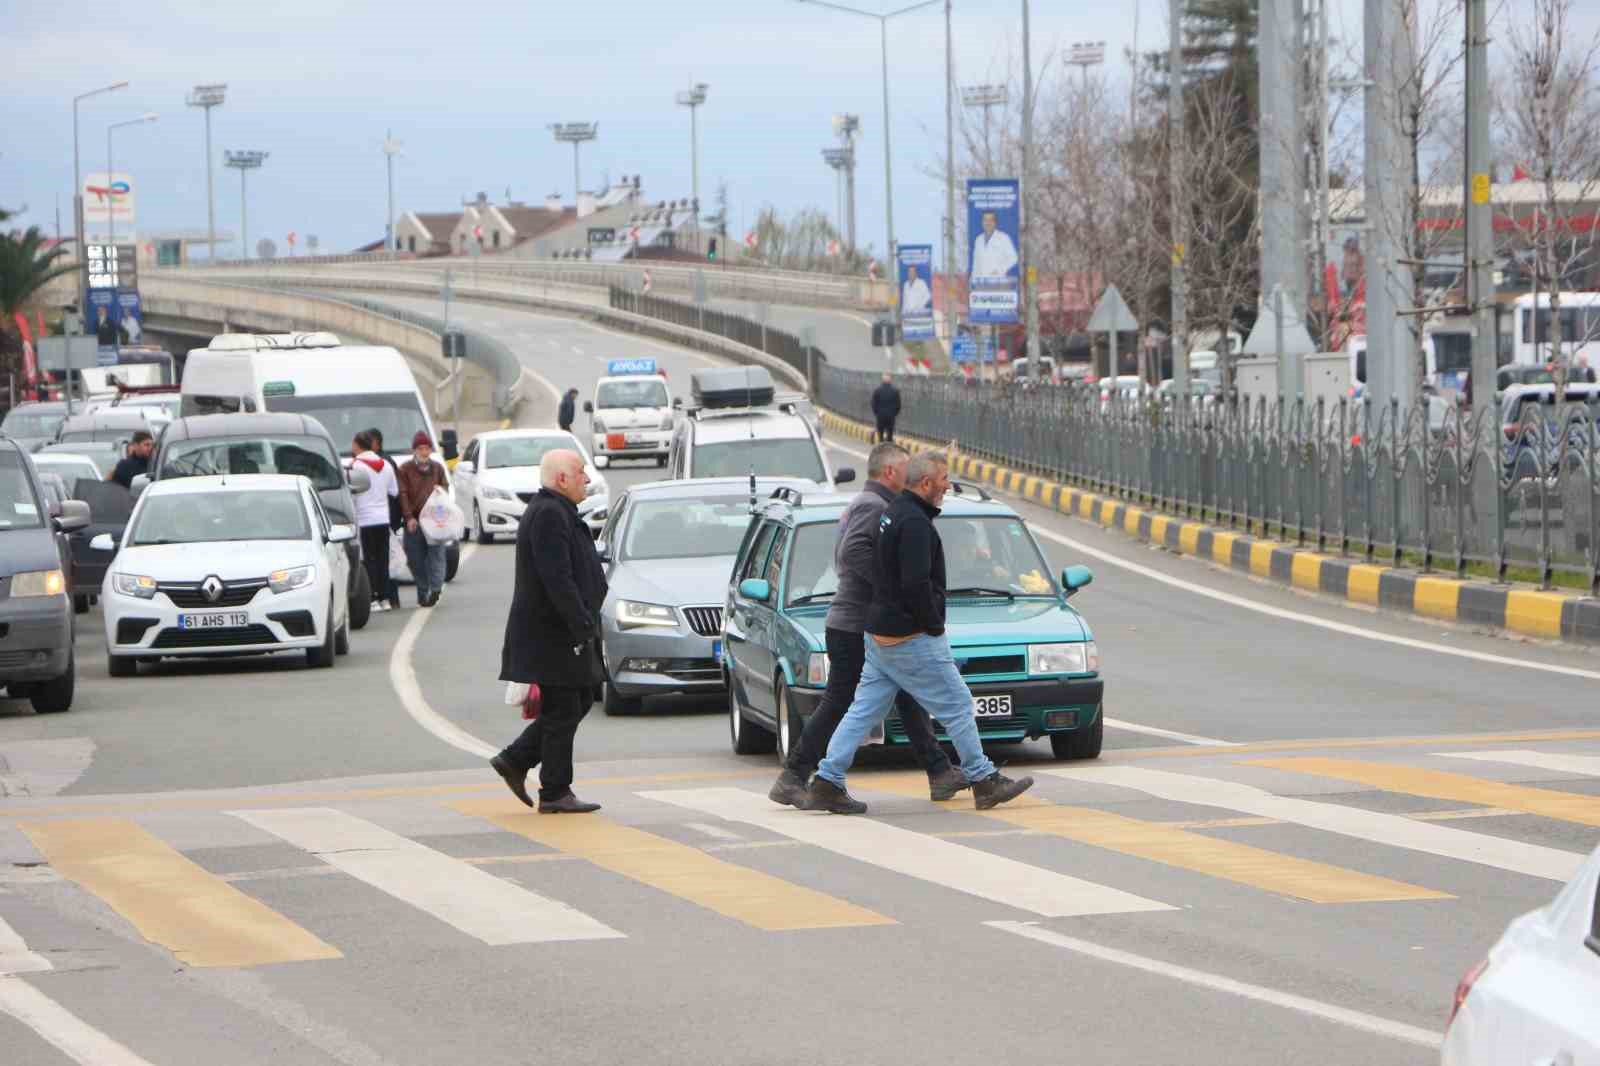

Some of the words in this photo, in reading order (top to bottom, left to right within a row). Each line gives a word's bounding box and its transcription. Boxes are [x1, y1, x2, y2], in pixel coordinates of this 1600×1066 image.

[184, 616, 197, 627] 61
[201, 615, 224, 626] AHS
[230, 614, 247, 625] 113
[976, 697, 1010, 714] 385
